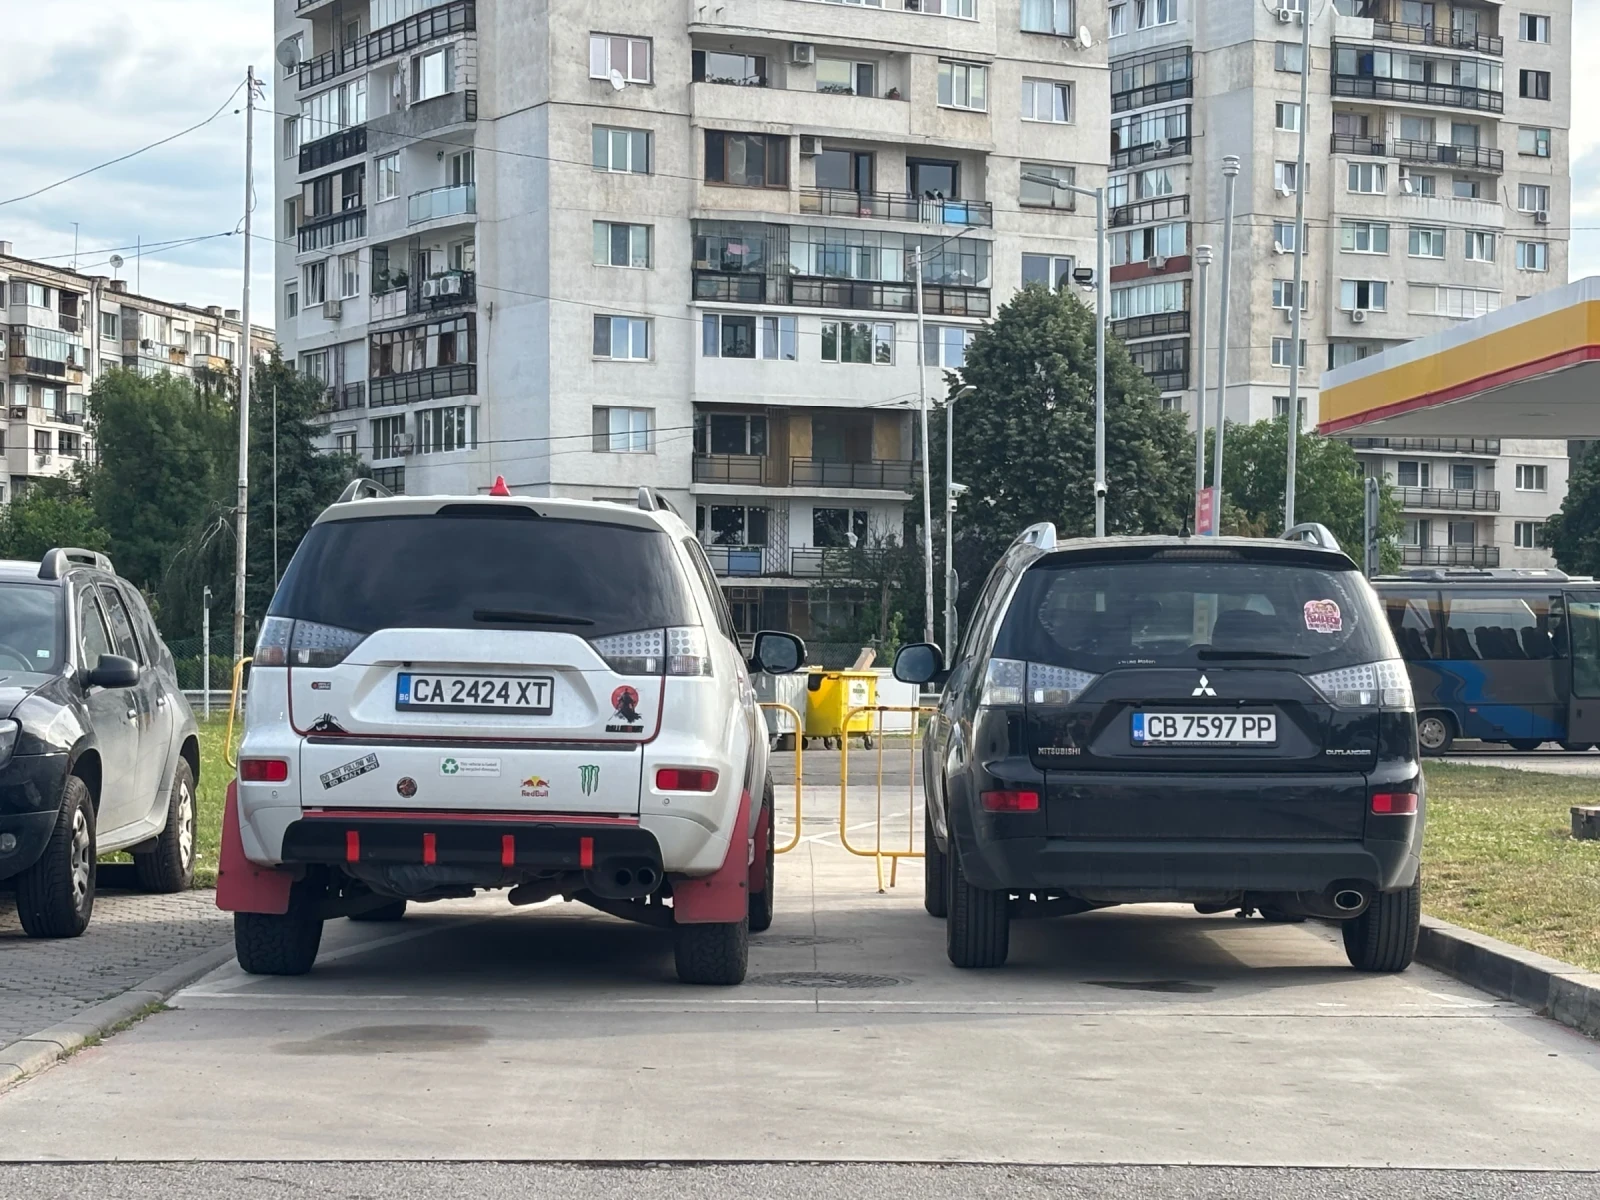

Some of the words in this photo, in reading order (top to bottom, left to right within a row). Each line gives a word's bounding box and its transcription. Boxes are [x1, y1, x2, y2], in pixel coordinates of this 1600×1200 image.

[414, 679, 445, 702] CA
[451, 680, 510, 704] 2424
[516, 682, 548, 705] XT
[1148, 716, 1177, 738] CB
[1182, 716, 1237, 738] 7597
[1242, 716, 1272, 738] PP
[1038, 747, 1080, 755] MITSUBISHI
